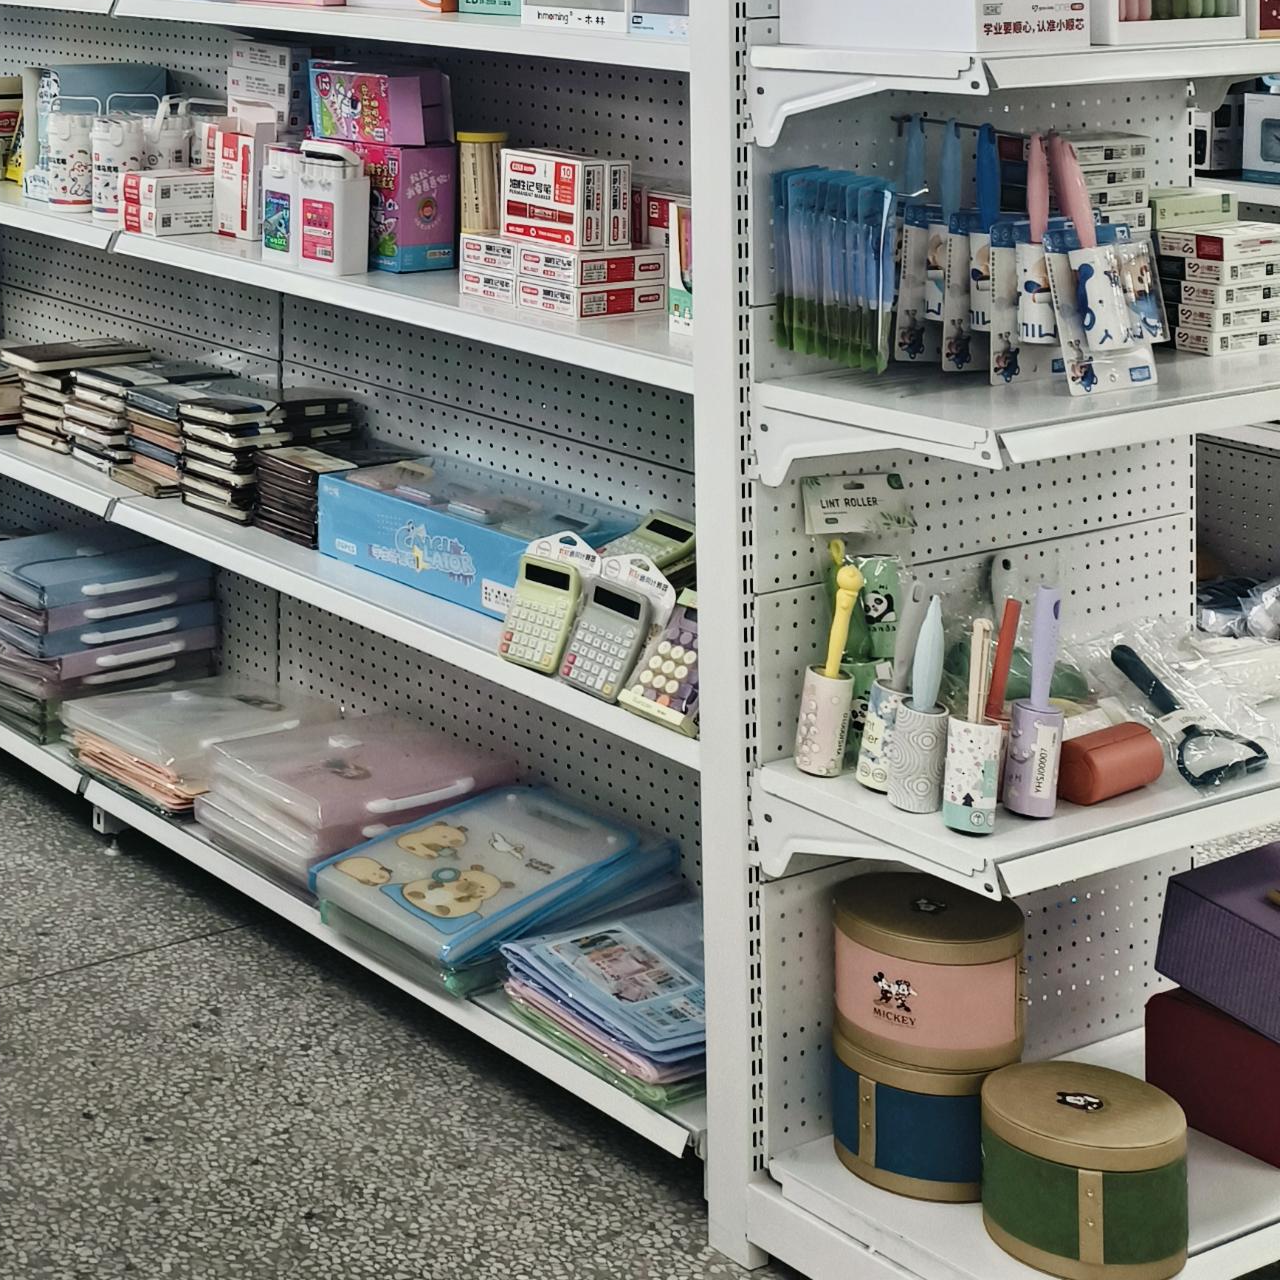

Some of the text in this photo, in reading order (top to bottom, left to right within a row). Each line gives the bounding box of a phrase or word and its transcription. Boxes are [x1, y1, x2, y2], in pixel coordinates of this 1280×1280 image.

[820, 496, 879, 509] LINT ROLLER
[872, 1006, 918, 1027] MICKEY
